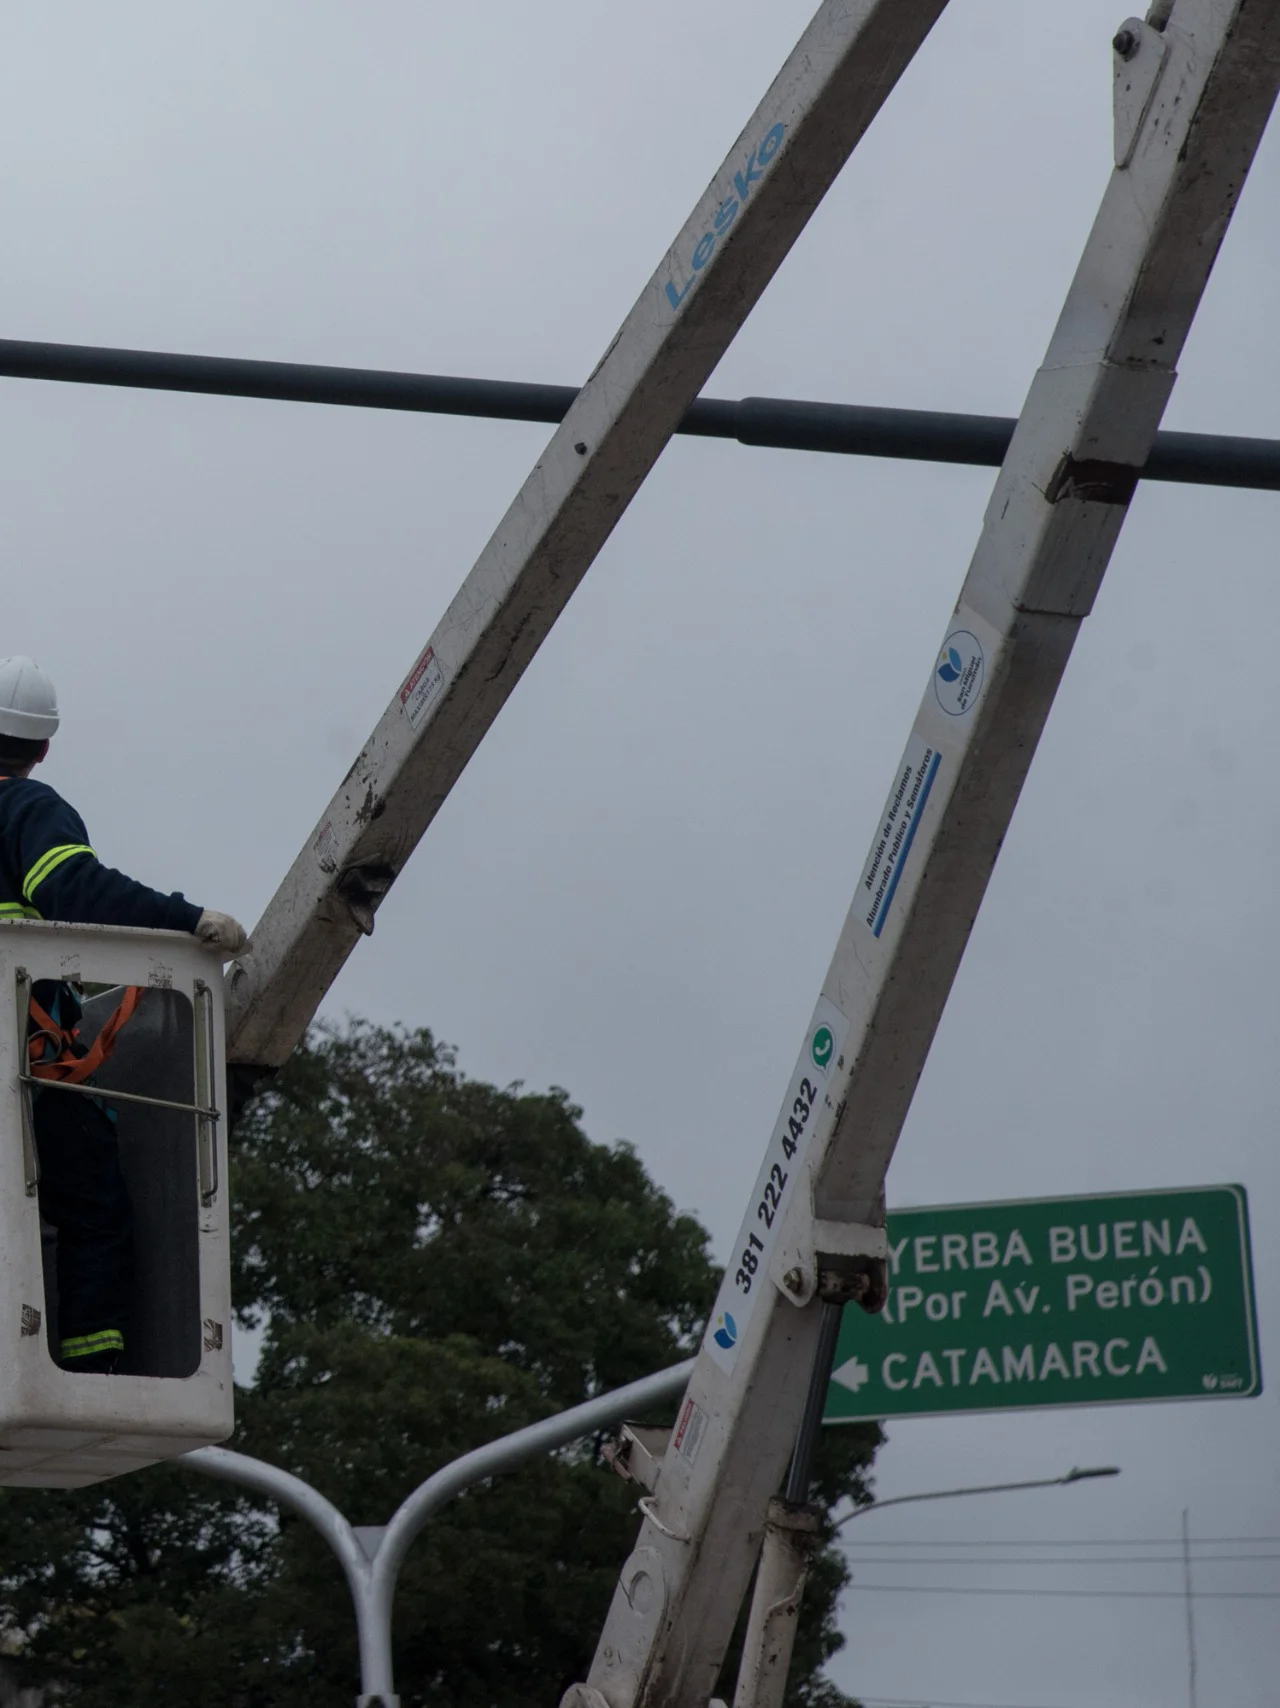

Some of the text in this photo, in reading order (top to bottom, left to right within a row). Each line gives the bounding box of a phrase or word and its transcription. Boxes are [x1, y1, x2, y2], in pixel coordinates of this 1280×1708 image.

[962, 656, 977, 686] Miguel
[906, 747, 933, 810] Semáforos
[865, 765, 913, 891] Atención de Reclamos
[903, 811, 912, 821] y
[865, 865, 892, 928] Alumbrado
[735, 1077, 818, 1295] 381 222 4432
[887, 1216, 1208, 1274] YERBA BUENA
[983, 1280, 1051, 1318] Av.
[1066, 1265, 1212, 1311] Perón)
[881, 1336, 1168, 1390] CATAMARCA
